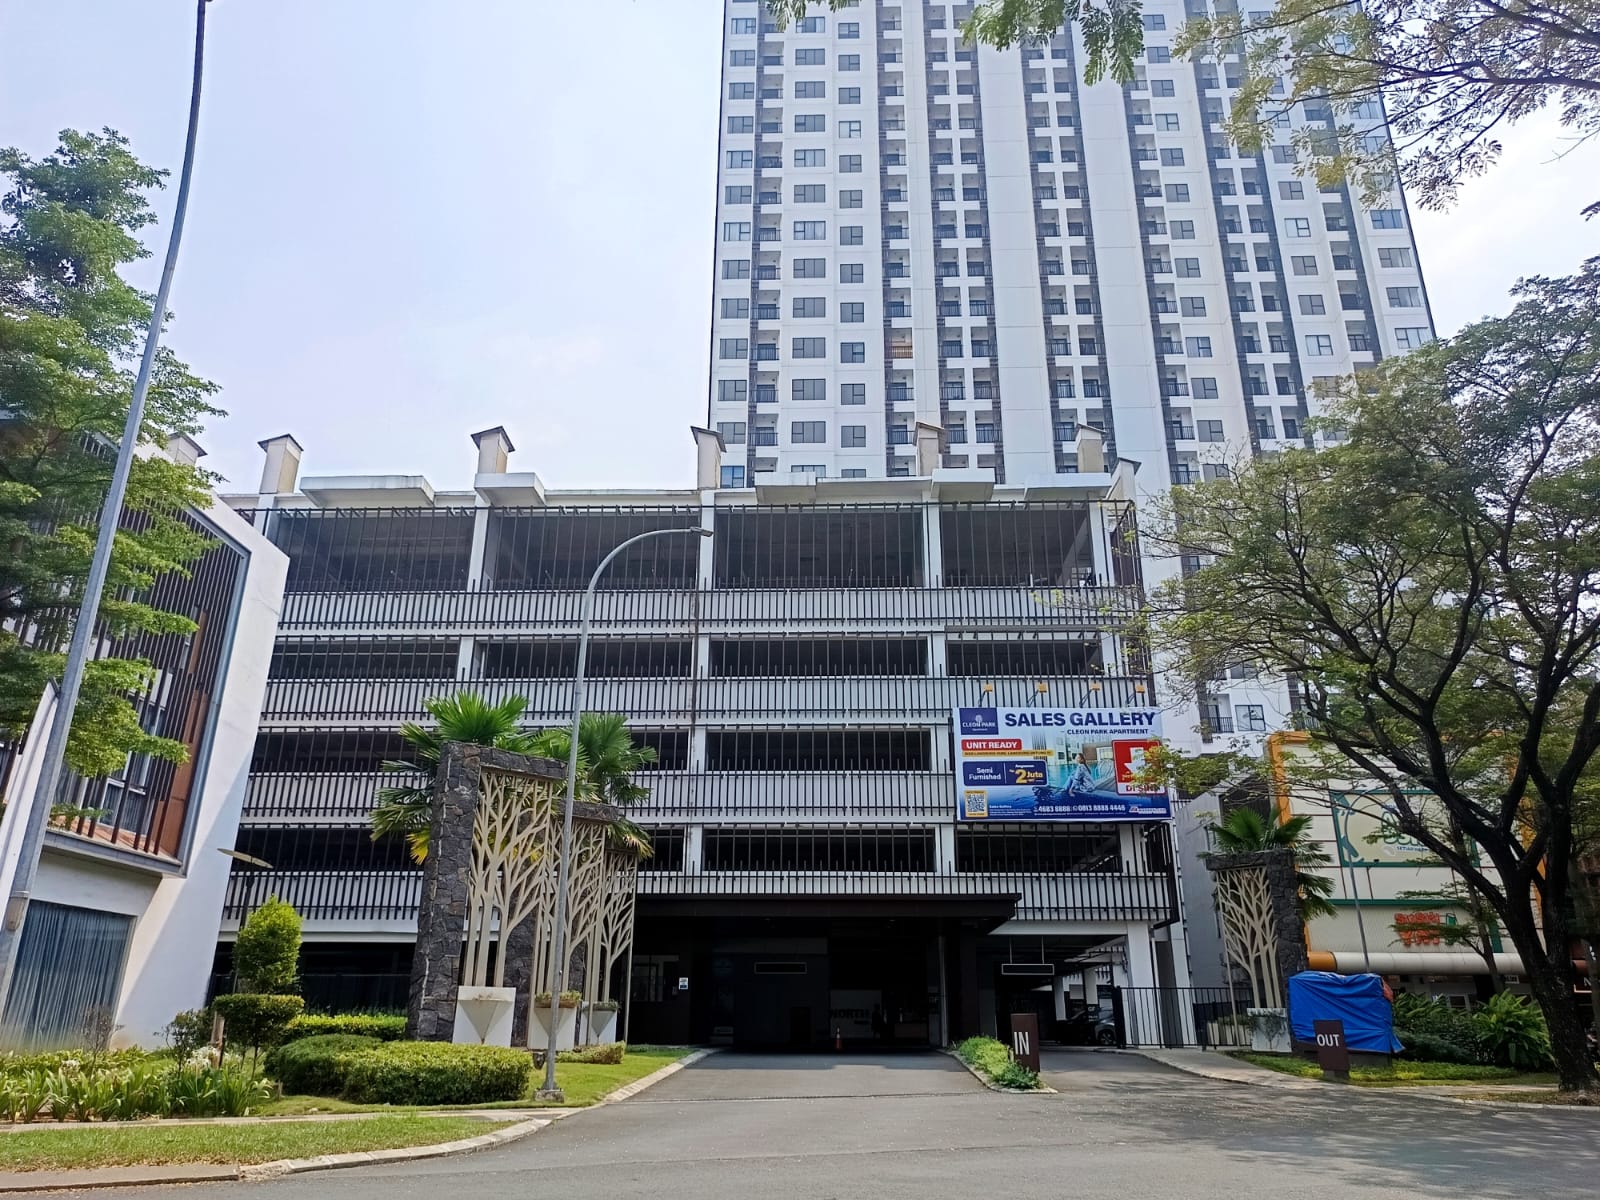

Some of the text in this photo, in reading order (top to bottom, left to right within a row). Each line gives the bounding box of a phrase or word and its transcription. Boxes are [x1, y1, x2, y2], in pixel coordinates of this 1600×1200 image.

[1005, 712, 1155, 727] SALES GALLERY
[1015, 769, 1027, 784] 2
[1013, 1031, 1030, 1055] IN
[1316, 1033, 1340, 1047] OUT
